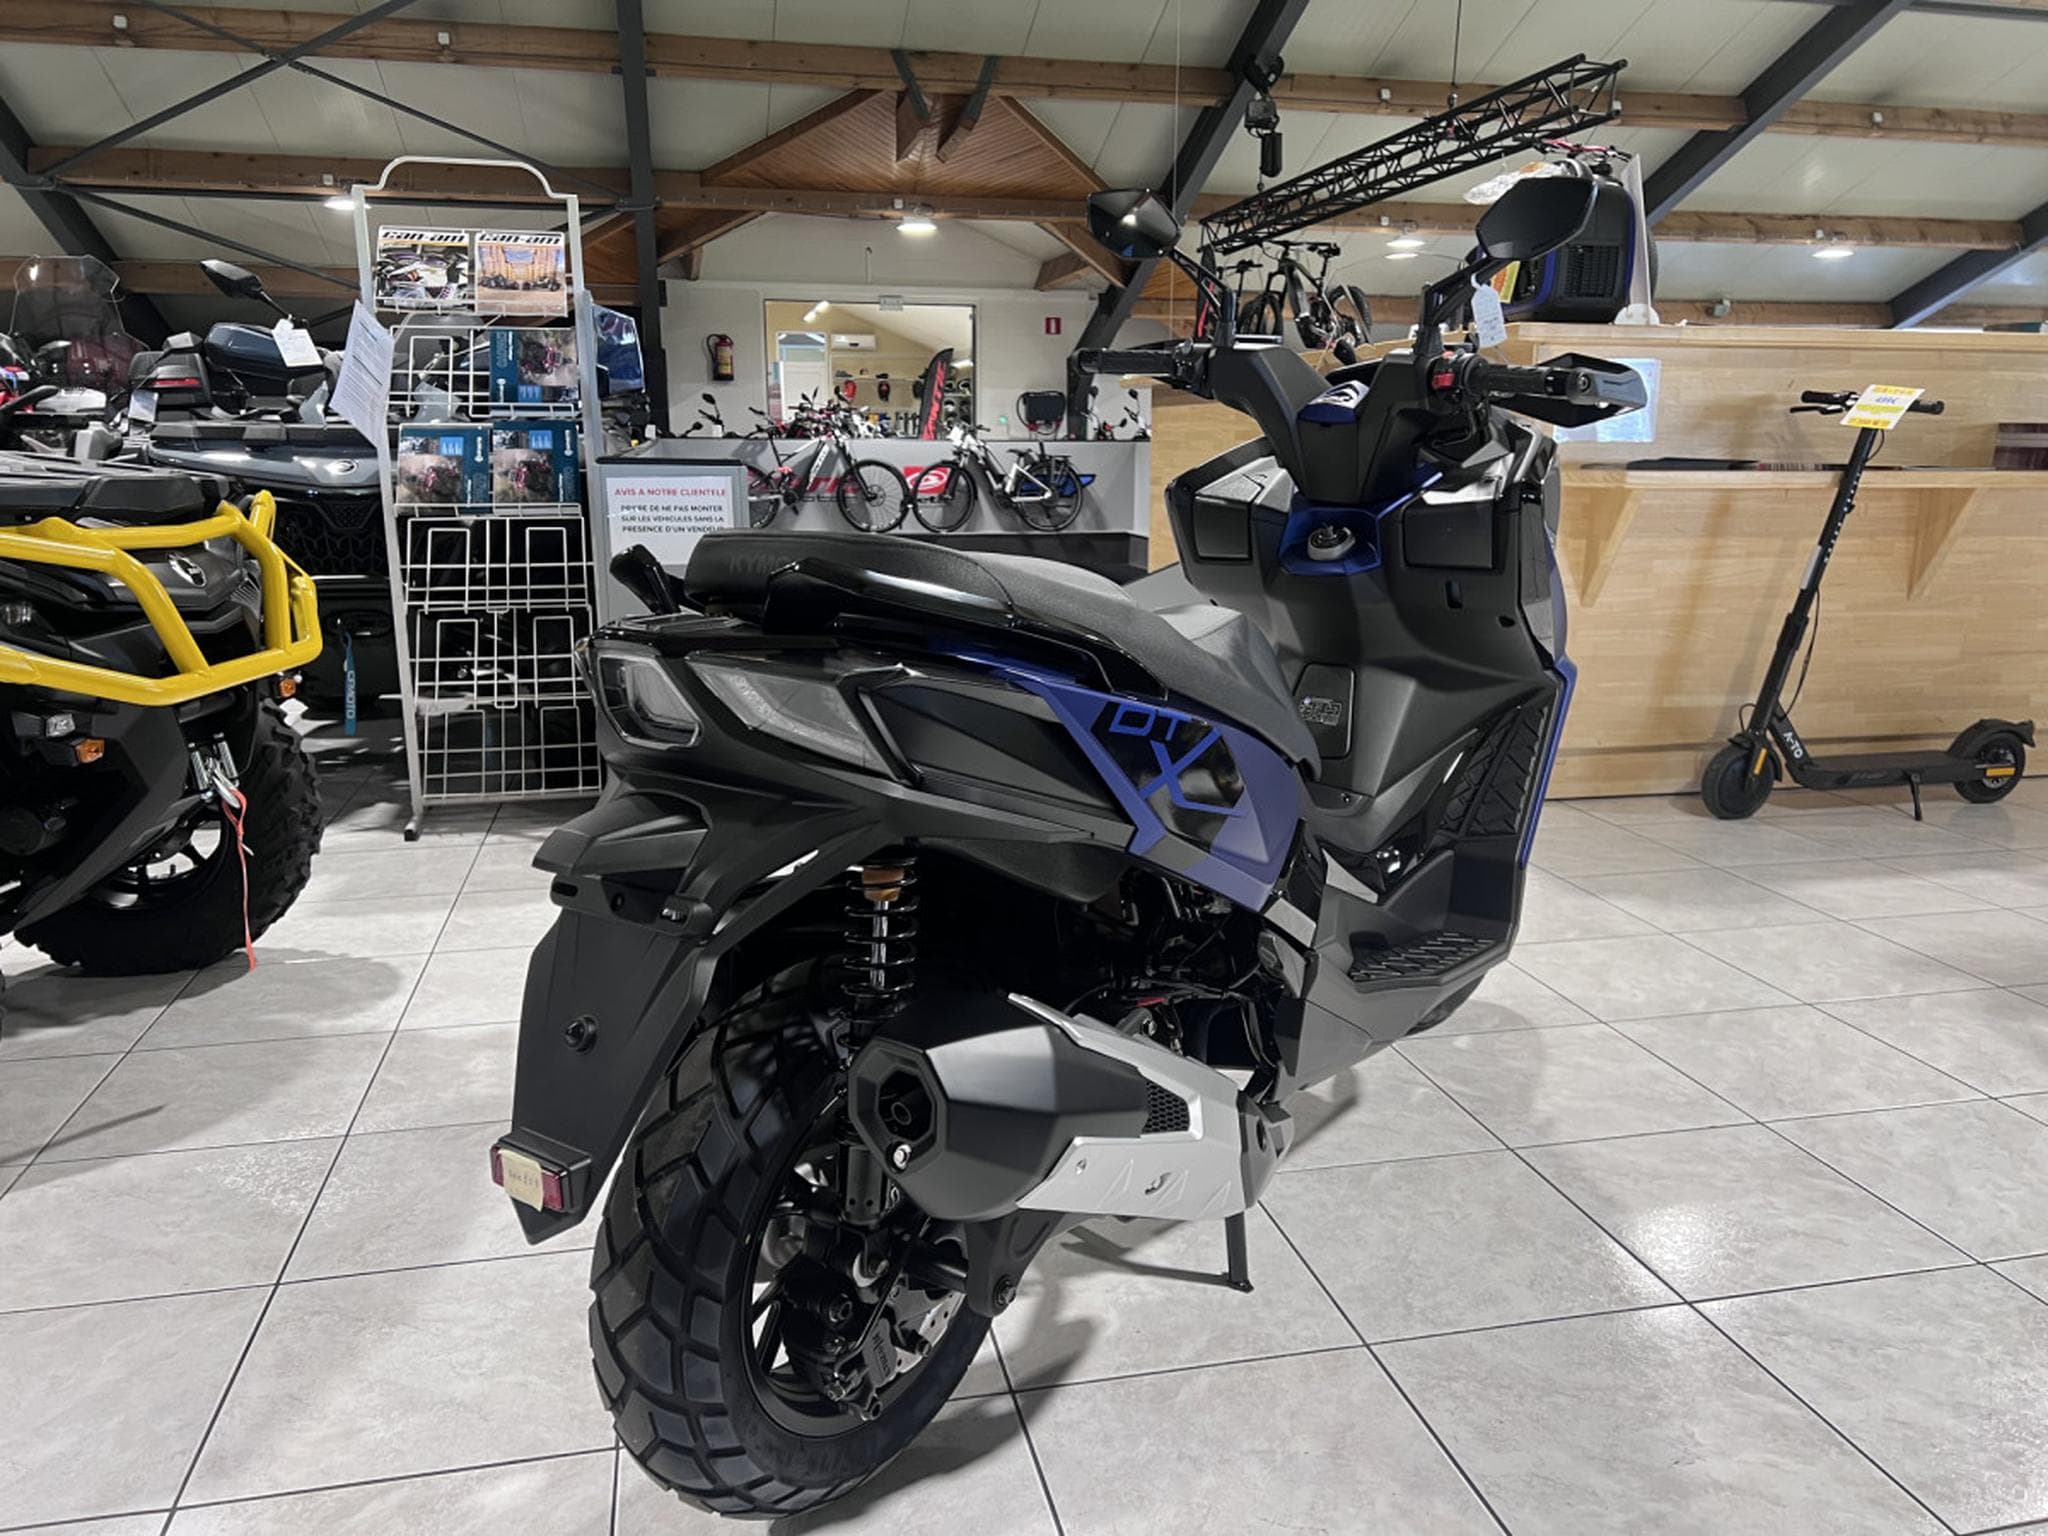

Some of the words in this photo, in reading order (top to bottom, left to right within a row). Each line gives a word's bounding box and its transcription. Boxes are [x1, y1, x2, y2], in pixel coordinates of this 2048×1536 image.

[615, 488, 636, 496] AVIS
[639, 488, 645, 496] A
[647, 488, 677, 496] NOTRE
[680, 488, 725, 496] CLIENTELE
[650, 504, 659, 512] DE
[661, 504, 671, 512] NE
[673, 504, 689, 512] PAS
[690, 504, 723, 512] MONTER
[622, 525, 663, 533] PRESENCE
[665, 525, 685, 533] D'UN
